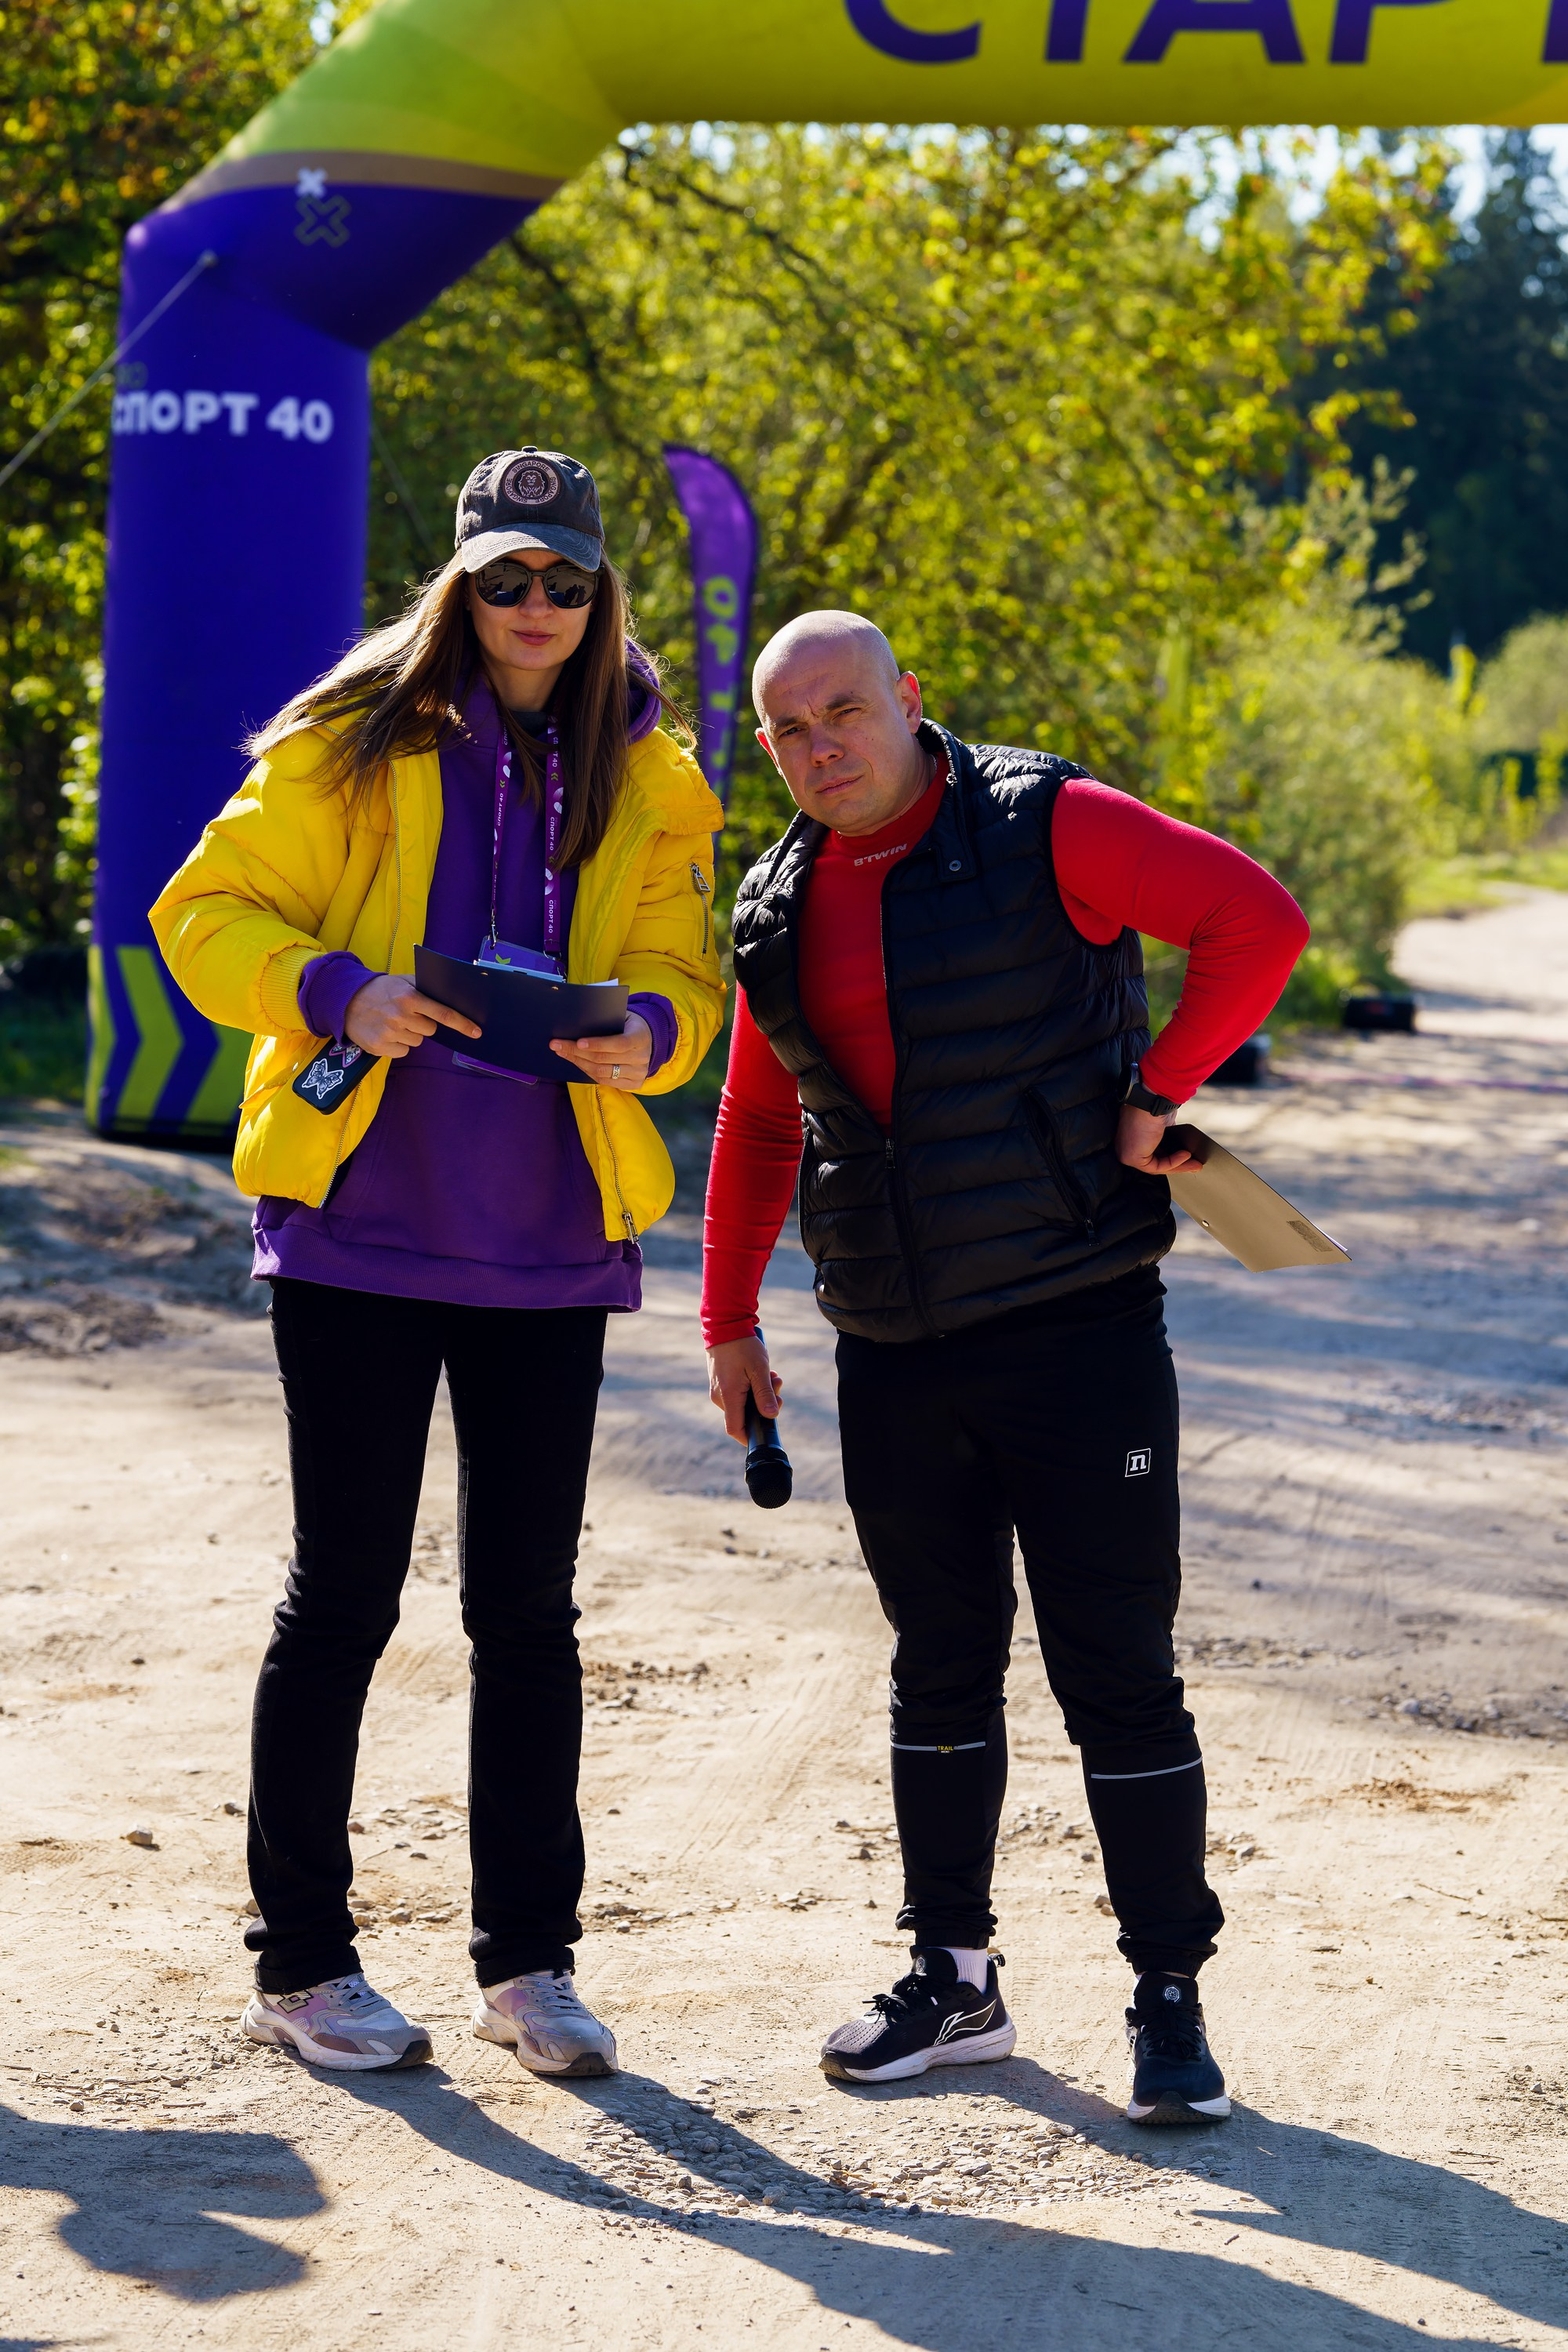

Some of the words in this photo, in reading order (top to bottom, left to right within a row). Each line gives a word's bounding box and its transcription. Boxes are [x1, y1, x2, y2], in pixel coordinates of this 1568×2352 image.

[265, 396, 334, 445] 40
[512, 461, 550, 474] SINGAPORE
[506, 478, 528, 503] SINGAPORE
[550, 841, 554, 851] 40
[548, 924, 554, 934] 40
